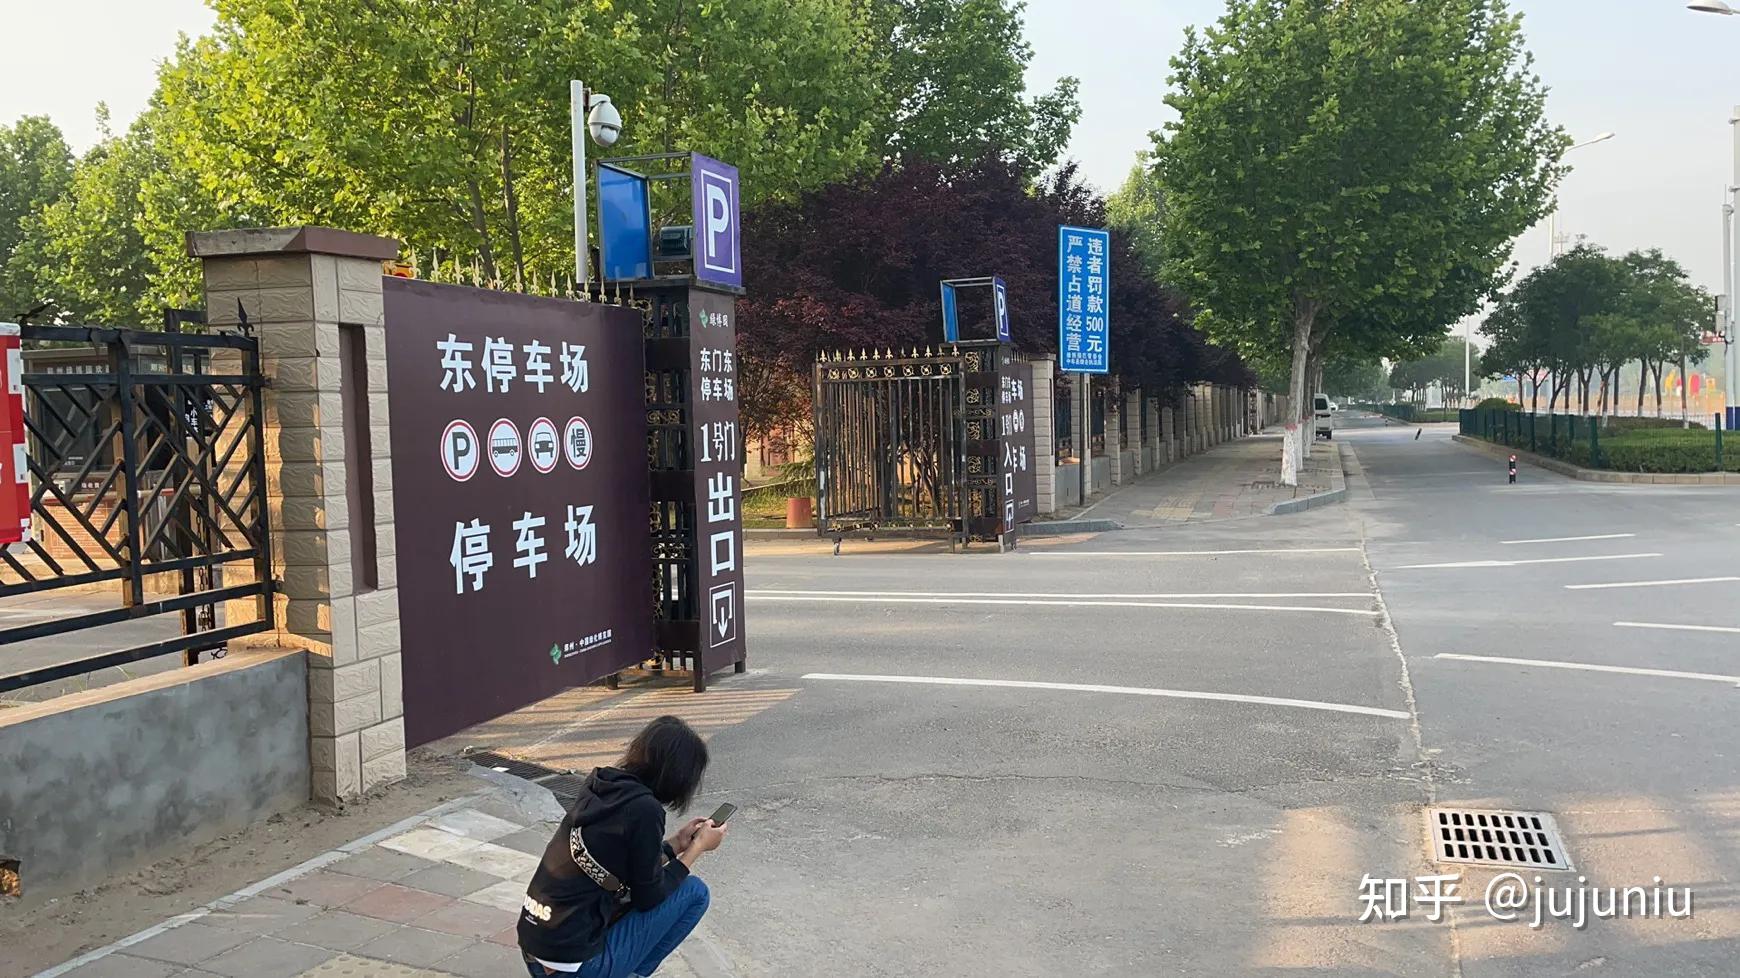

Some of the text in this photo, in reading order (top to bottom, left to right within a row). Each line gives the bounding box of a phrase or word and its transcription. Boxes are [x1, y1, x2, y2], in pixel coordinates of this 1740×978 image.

[706, 183, 730, 257] P
[997, 291, 1005, 329] P
[1066, 234, 1083, 352] 严禁占道经营
[1086, 237, 1104, 353] 违者罚款500元
[436, 333, 590, 394] 东停车场
[700, 347, 733, 373] 东门东
[700, 376, 734, 401] 停车场
[452, 430, 471, 470] P
[570, 427, 587, 459] 慢
[700, 421, 736, 463] 1号门
[449, 504, 598, 595] 停车场
[708, 471, 735, 577] 出口
